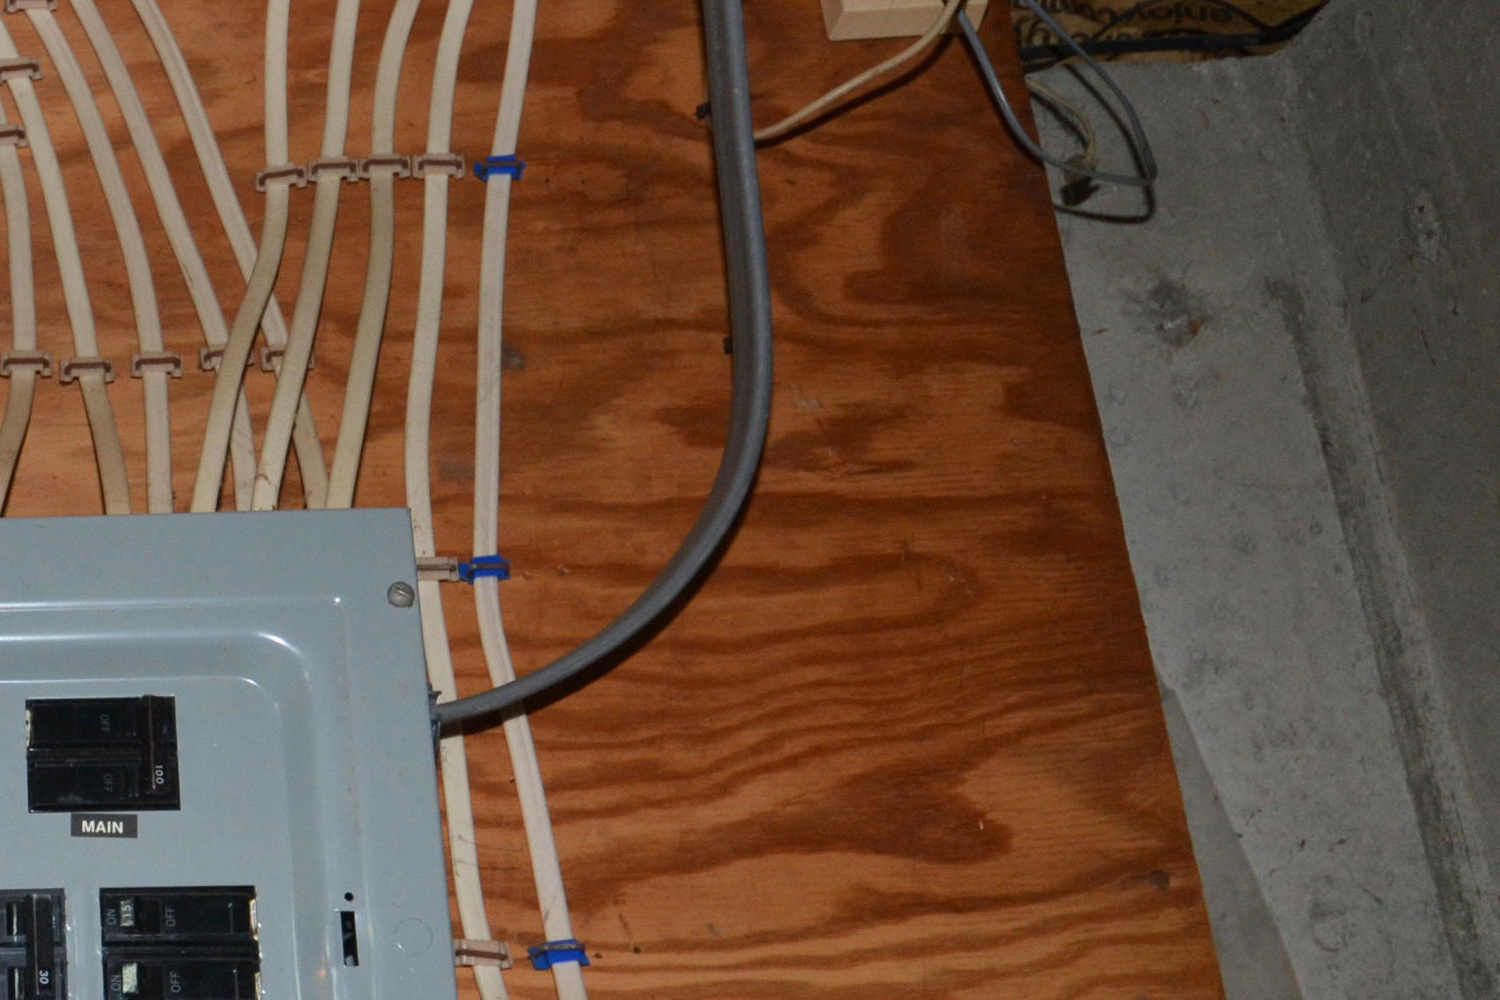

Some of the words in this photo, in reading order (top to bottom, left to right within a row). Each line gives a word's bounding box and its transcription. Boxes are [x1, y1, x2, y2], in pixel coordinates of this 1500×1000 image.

[155, 765, 163, 784] 100
[82, 821, 123, 834] MAIN
[107, 909, 117, 925] ON
[165, 906, 176, 927] OFF
[39, 971, 48, 985] 30
[112, 975, 121, 991] ON
[171, 971, 181, 993] OFF
